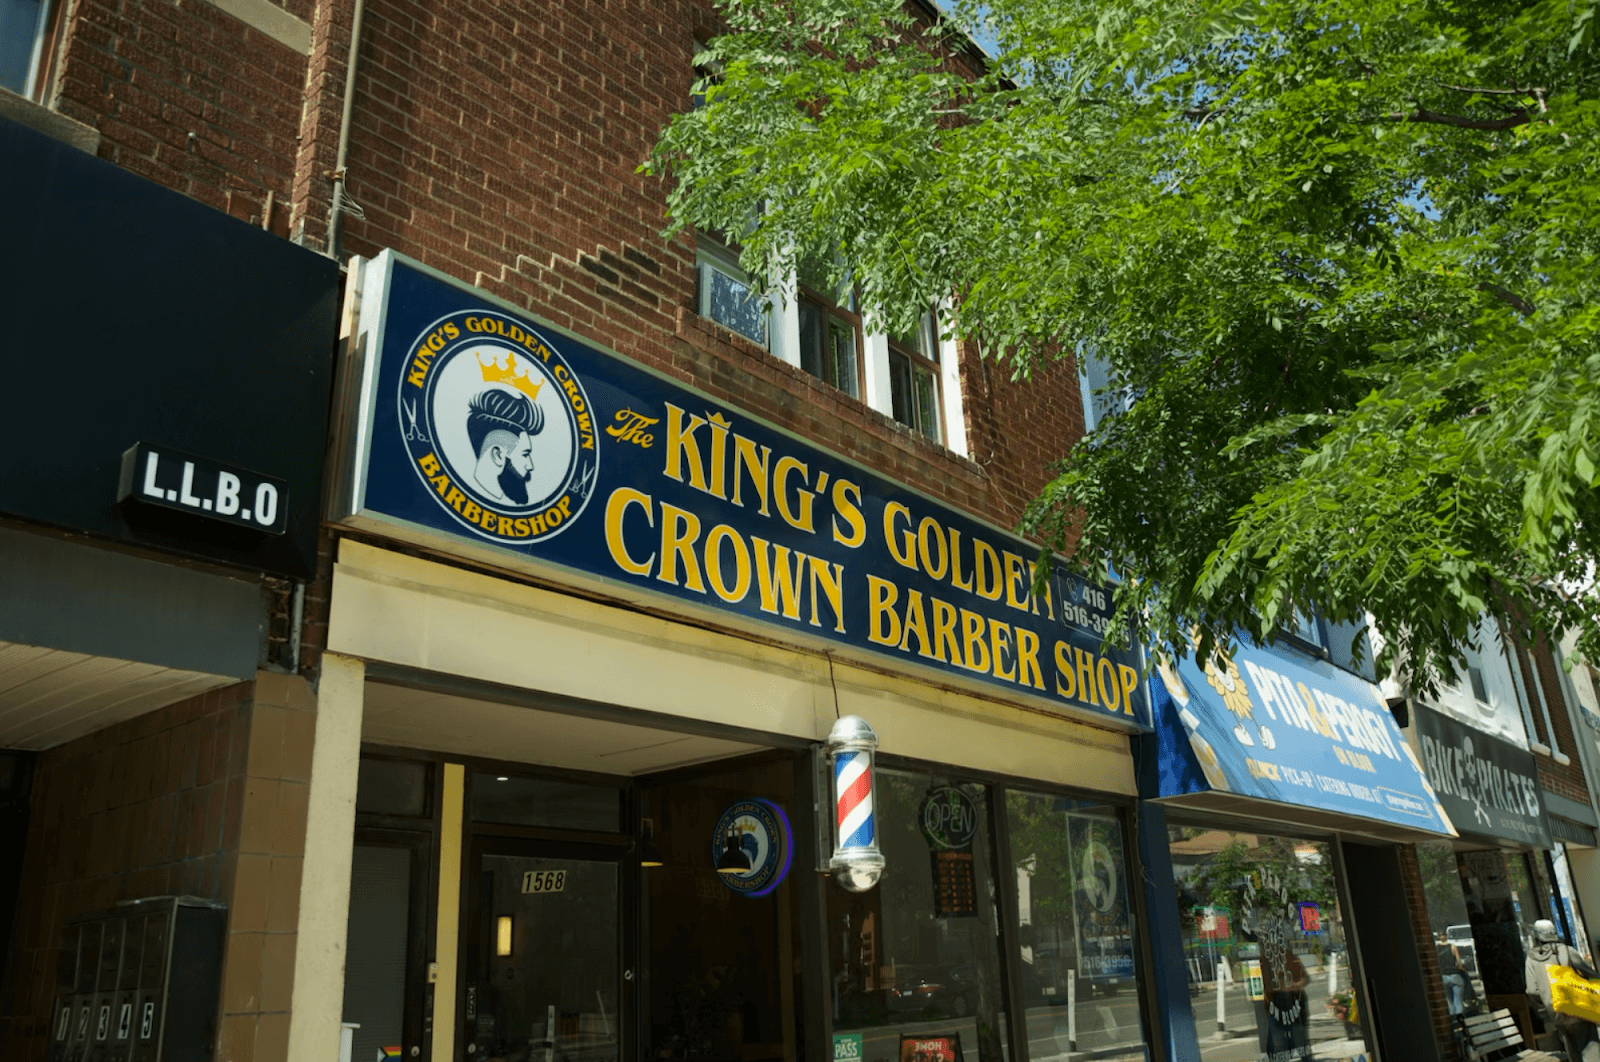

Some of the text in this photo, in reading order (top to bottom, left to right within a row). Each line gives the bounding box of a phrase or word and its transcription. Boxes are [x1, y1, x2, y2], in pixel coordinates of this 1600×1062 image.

[407, 316, 594, 451] KING'S GOLDEN CROWN
[143, 451, 278, 526] L.L.B.O
[418, 452, 574, 537] BARBERSHOP
[605, 407, 660, 449] The
[663, 401, 867, 548] KING'S
[604, 487, 1138, 716] CROWN BARBER SHOP
[1082, 586, 1106, 611] 416
[1422, 735, 1540, 818] BIKE PIRATES
[927, 803, 972, 832] OPEN
[526, 871, 565, 892] 1568
[721, 866, 769, 889] ARBERSHOP
[97, 1006, 109, 1039] 3
[119, 1004, 131, 1038] 4
[142, 1003, 153, 1037] 5
[835, 1042, 858, 1059] PASS
